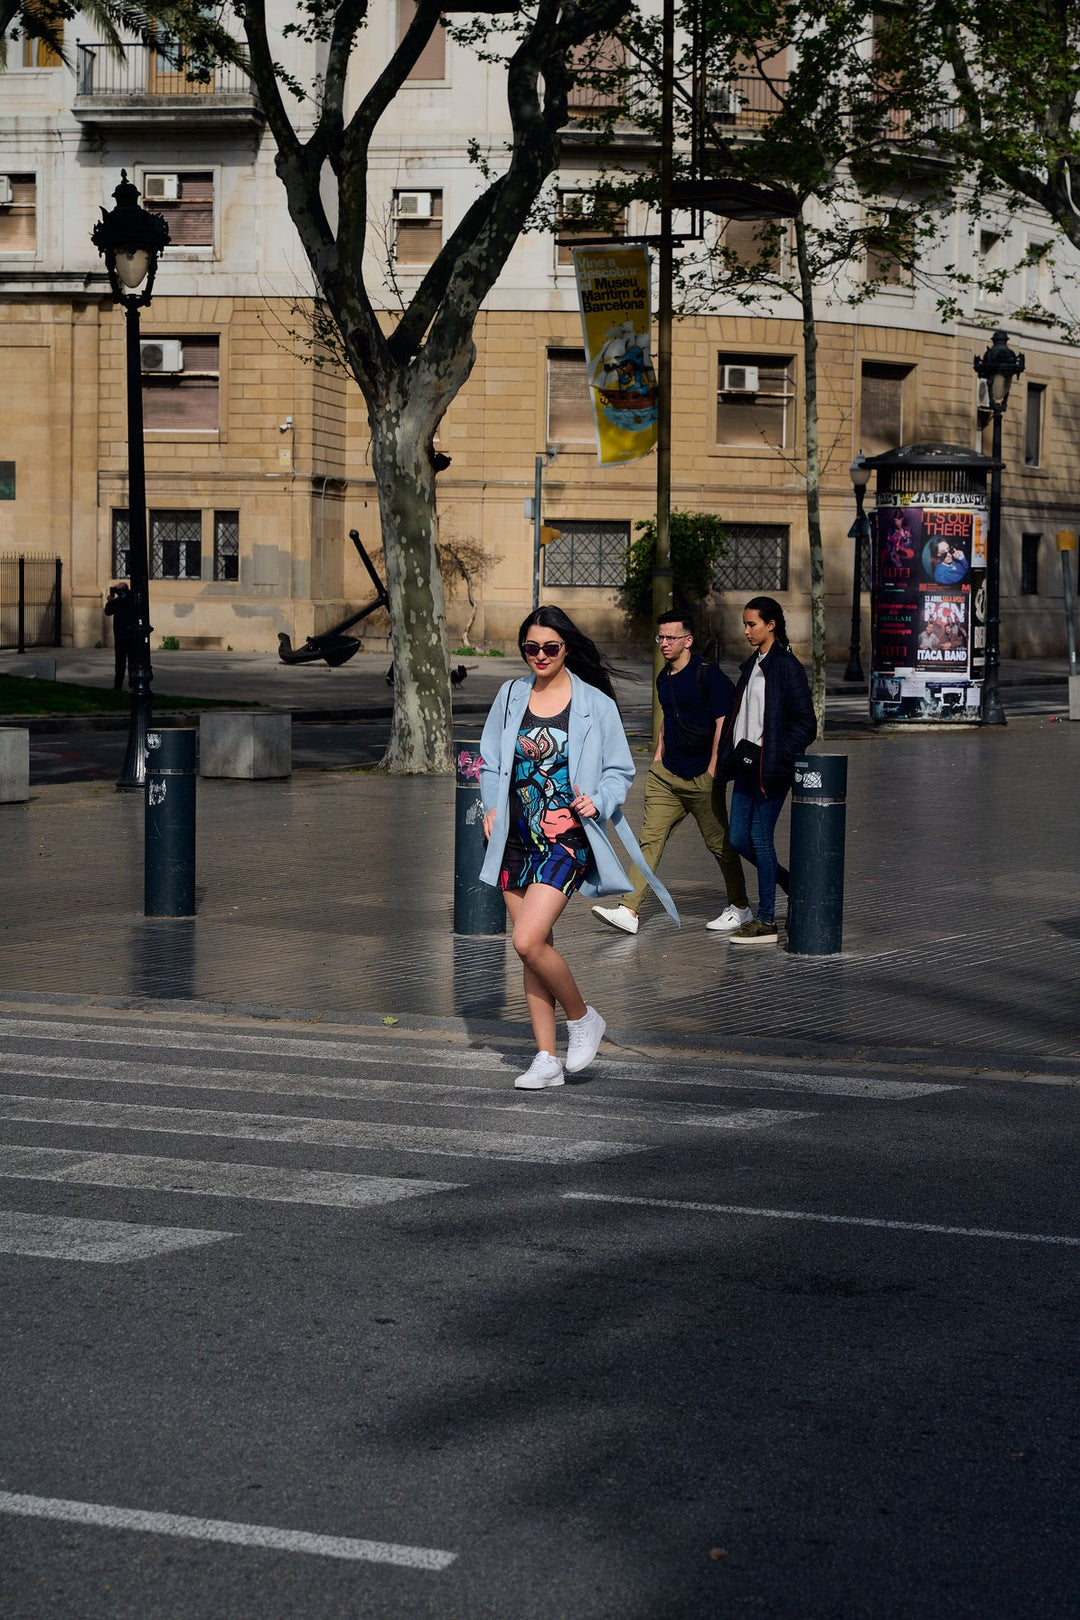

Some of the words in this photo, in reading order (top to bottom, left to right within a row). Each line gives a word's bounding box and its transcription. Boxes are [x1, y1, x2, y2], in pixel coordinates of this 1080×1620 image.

[577, 257, 605, 269] Vine
[608, 258, 616, 268] a
[579, 265, 638, 280] descobrir
[595, 278, 637, 290] Museu
[633, 287, 647, 298] de
[583, 299, 645, 313] Barcelona
[924, 522, 970, 537] THERE
[924, 601, 966, 623] BCN
[917, 649, 943, 661] ITACA
[944, 650, 967, 662] BAND
